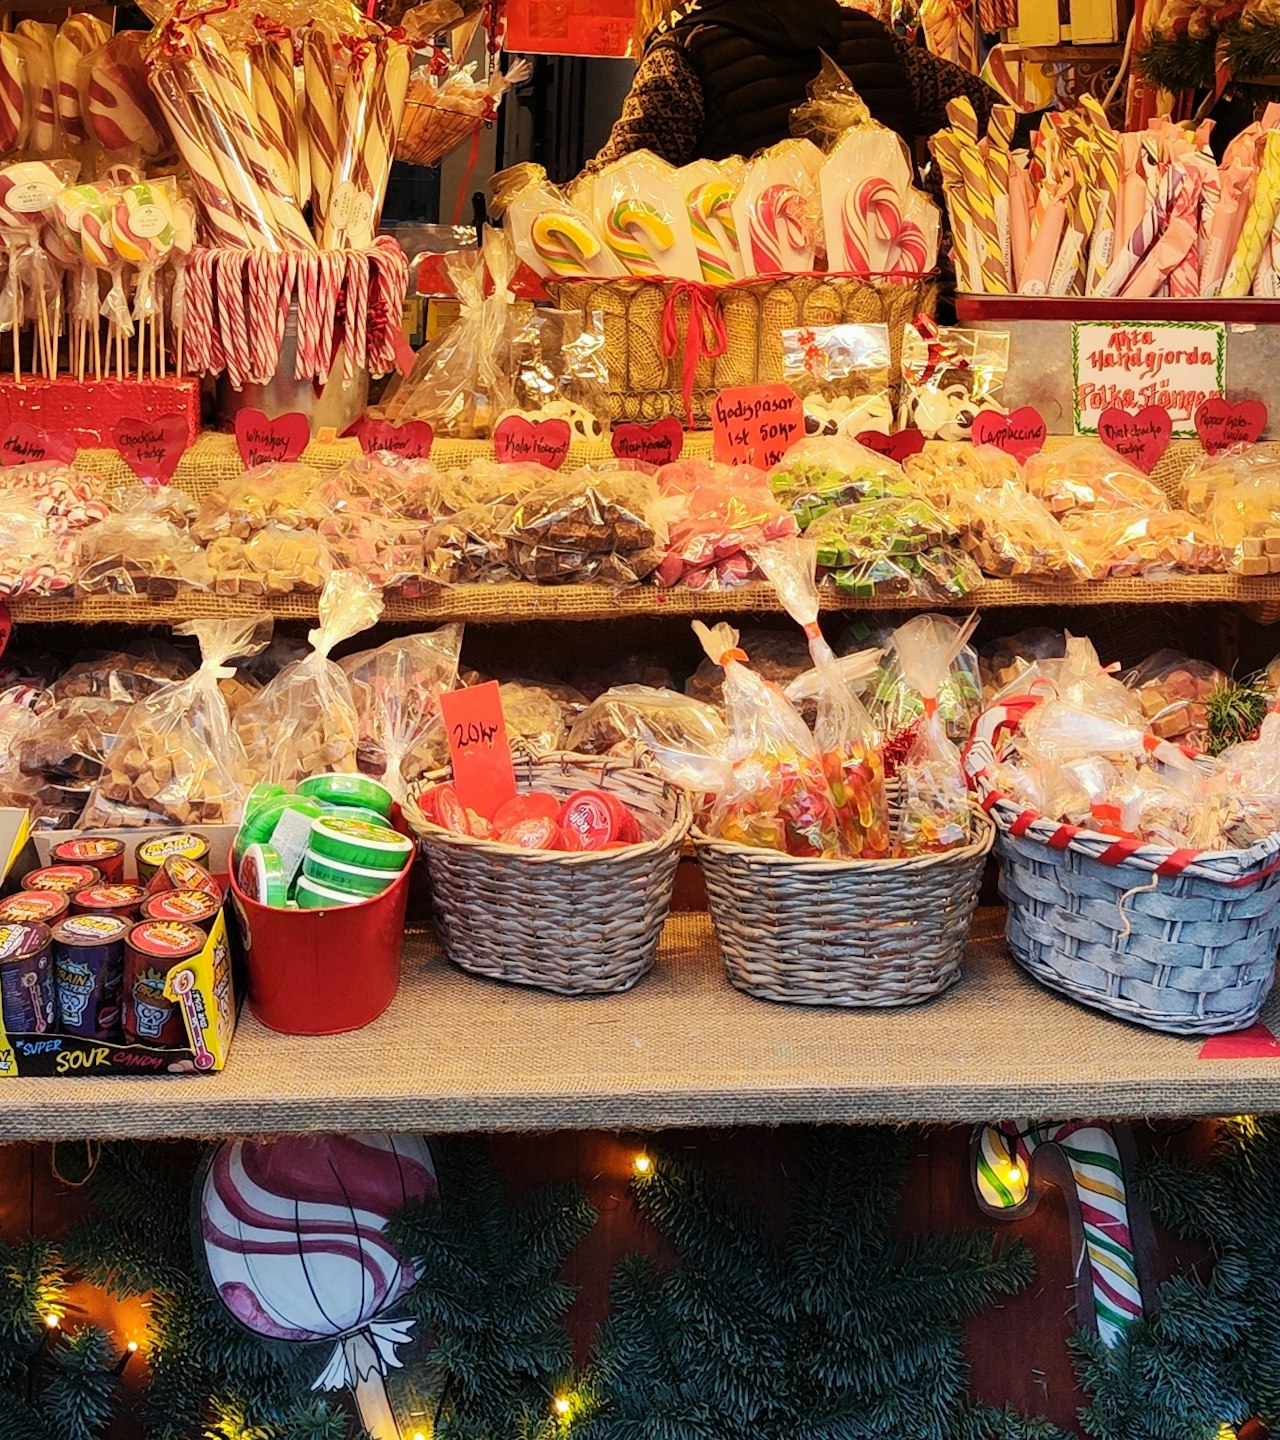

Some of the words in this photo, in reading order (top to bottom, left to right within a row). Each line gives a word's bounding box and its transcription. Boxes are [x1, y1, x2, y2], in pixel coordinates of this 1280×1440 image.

[1086, 346, 1218, 381] Handgjorda
[453, 722, 498, 749] 20kr
[23, 1039, 63, 1056] SUPER
[56, 1047, 112, 1073] SOUR
[113, 1051, 164, 1069] CANDY
